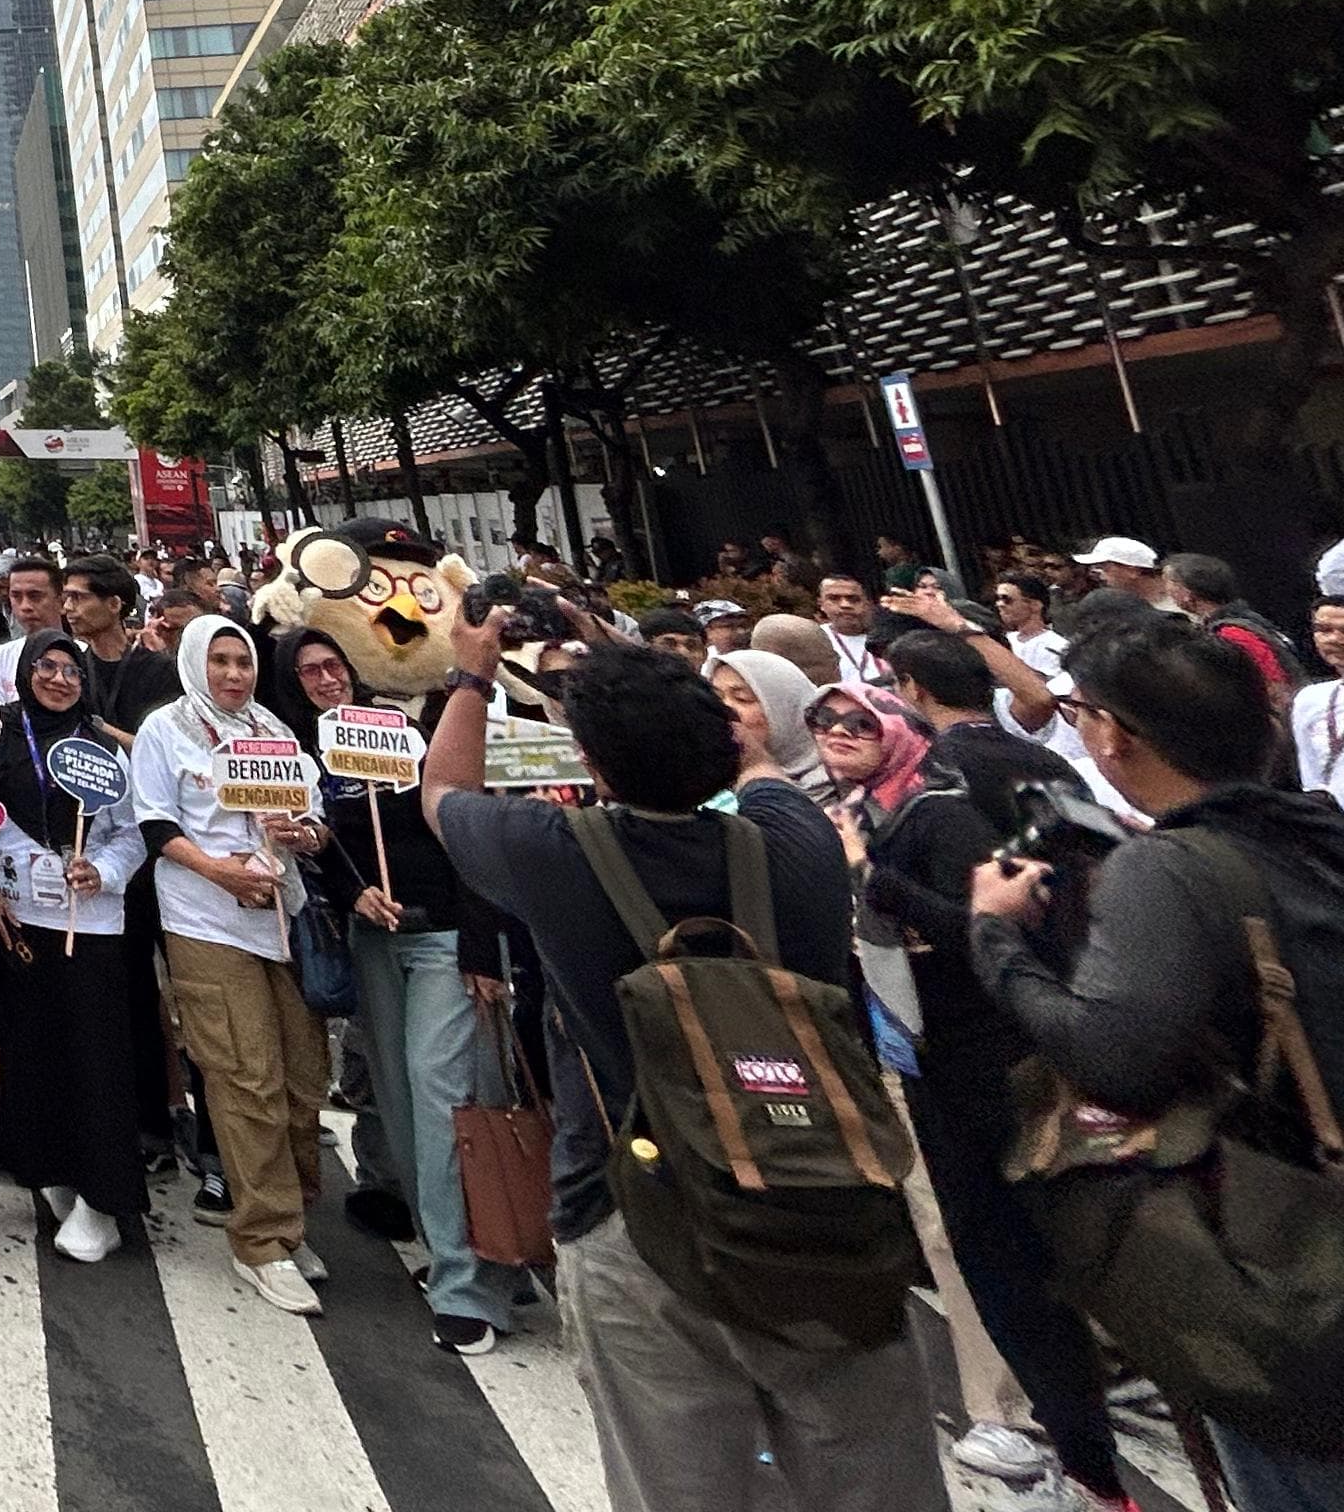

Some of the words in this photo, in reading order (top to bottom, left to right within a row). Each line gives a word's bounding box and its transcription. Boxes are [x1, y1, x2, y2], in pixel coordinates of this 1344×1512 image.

[156, 470, 188, 479] ASEAN
[336, 726, 411, 754] BERDAYA
[65, 755, 114, 781] PILKADA
[228, 760, 304, 782] BERDAYA
[331, 753, 413, 777] MENGAWASI
[224, 786, 306, 808] MENGAWASI
